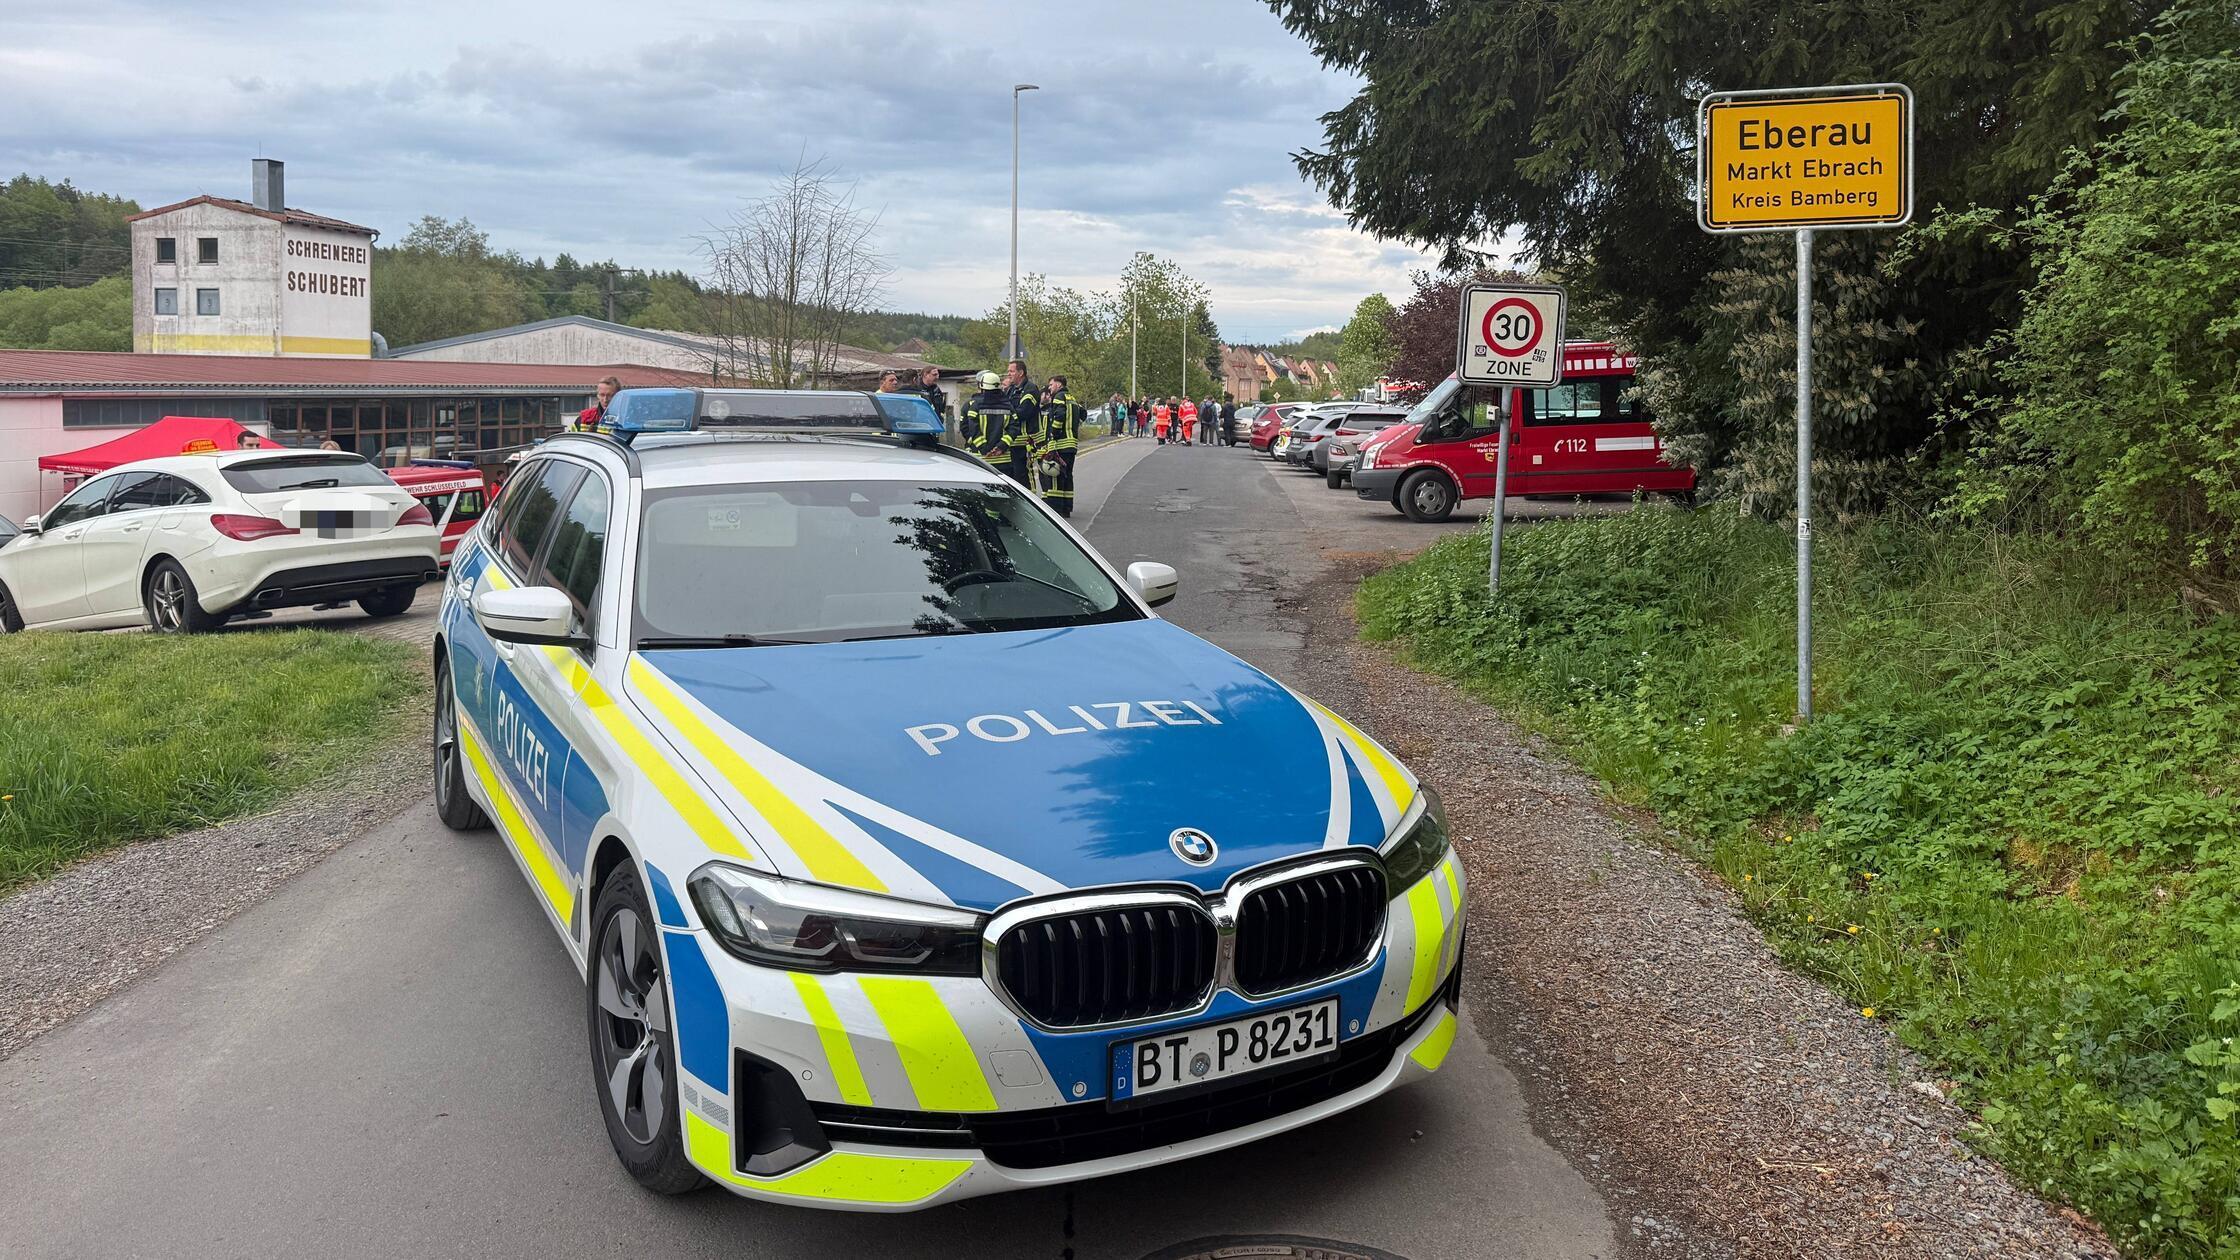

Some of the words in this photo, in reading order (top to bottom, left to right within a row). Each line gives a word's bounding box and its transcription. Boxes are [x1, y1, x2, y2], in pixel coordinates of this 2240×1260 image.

[1739, 119, 1871, 150] Eberau
[1728, 161, 1792, 181] Markt
[1803, 157, 1882, 178] Ebrach
[1732, 192, 1782, 209] Kreis
[1791, 189, 1877, 207] Bamberg
[287, 239, 366, 264] SCHREINEREI
[287, 271, 366, 297] SCHUBERT
[1495, 313, 1530, 341] 30
[1486, 360, 1533, 376] ZONE
[1566, 438, 1588, 453] 112
[904, 700, 1224, 756] POLIZEI
[497, 690, 549, 812] POLIZEI
[1117, 1076, 1126, 1090] D
[1137, 1037, 1189, 1088] BT
[1217, 1027, 1239, 1072] P
[1249, 1005, 1333, 1063] 8231
